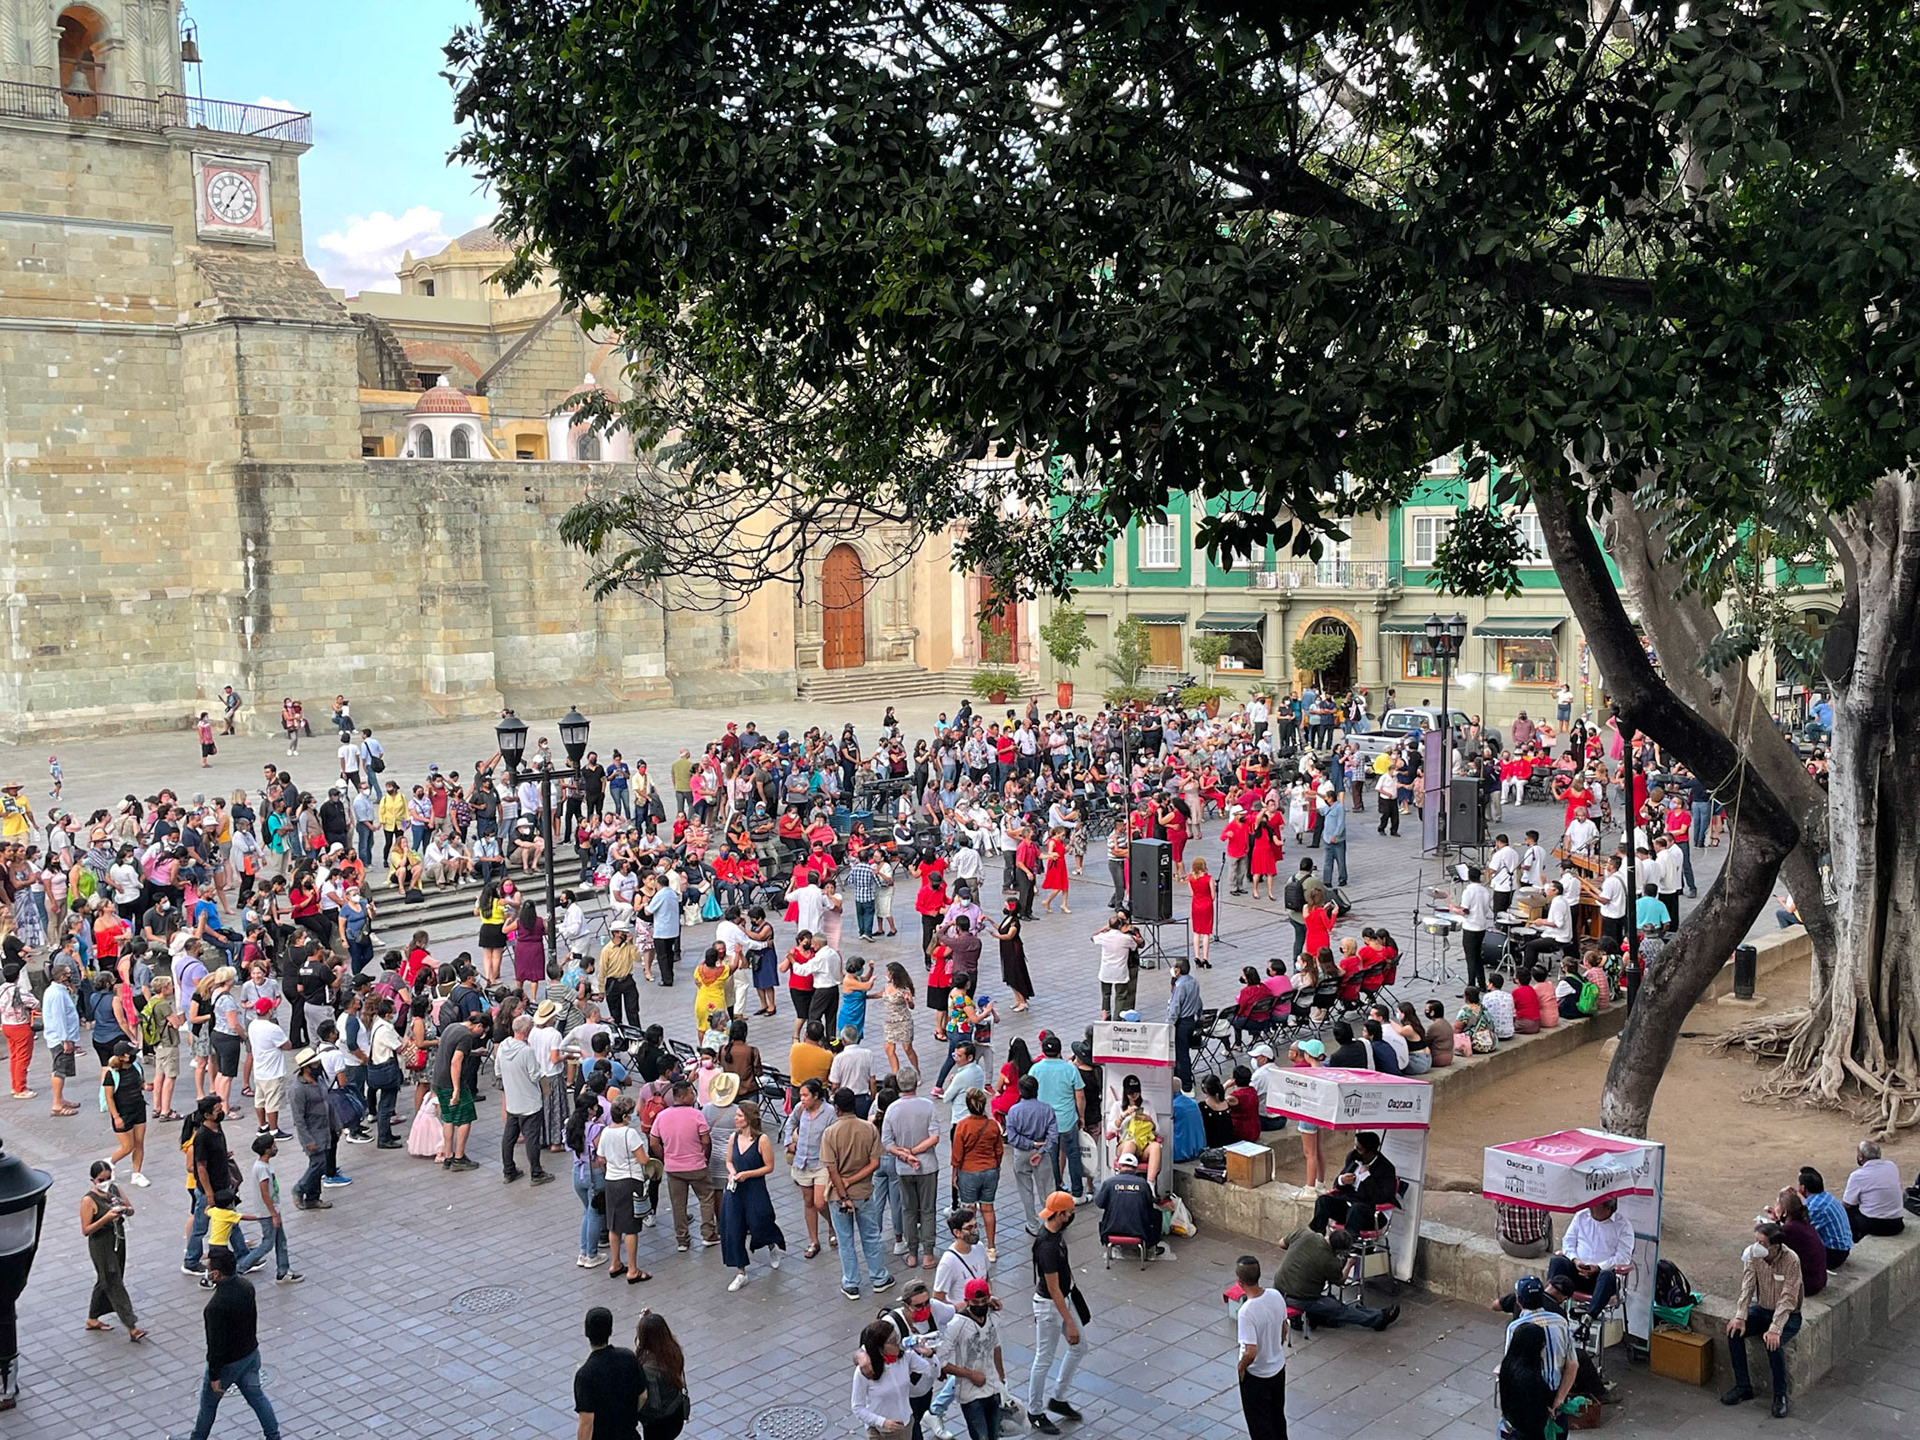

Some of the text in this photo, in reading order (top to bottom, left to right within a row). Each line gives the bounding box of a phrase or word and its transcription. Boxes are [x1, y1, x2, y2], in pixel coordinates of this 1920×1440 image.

[1320, 625, 1349, 638] HMV
[1113, 1025, 1137, 1033] Oaxaca
[1285, 1077, 1308, 1088] Oaxaca
[1387, 1098, 1414, 1109] Oaxaca
[1506, 1159, 1533, 1171] Oaxaca
